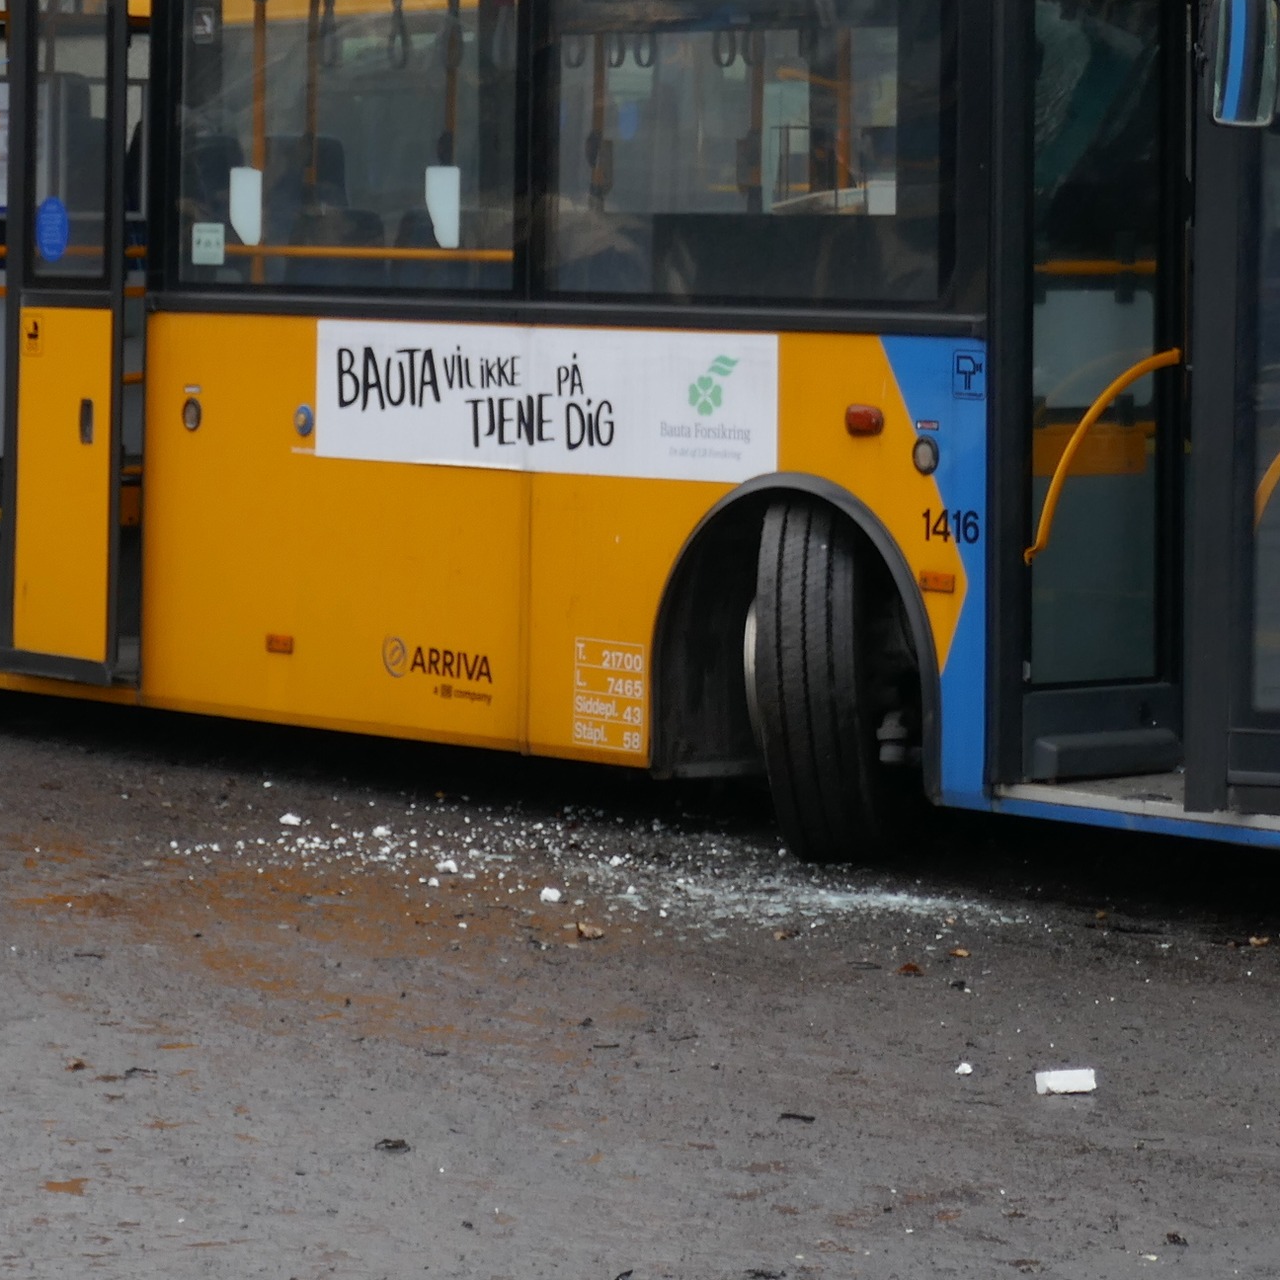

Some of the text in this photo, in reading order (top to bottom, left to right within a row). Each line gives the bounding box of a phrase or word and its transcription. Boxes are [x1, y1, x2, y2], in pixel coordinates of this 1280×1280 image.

[337, 347, 440, 411] BAUTA
[557, 353, 584, 396] PÅ
[466, 394, 554, 448] TJENE
[660, 421, 750, 444] Bauta Forsikring
[922, 509, 980, 544] 1416
[410, 646, 493, 684] ARRIVA
[602, 650, 643, 672] 21700
[607, 677, 643, 698] 7465
[575, 695, 642, 725] Siddepl. 43
[623, 732, 641, 750] 58
